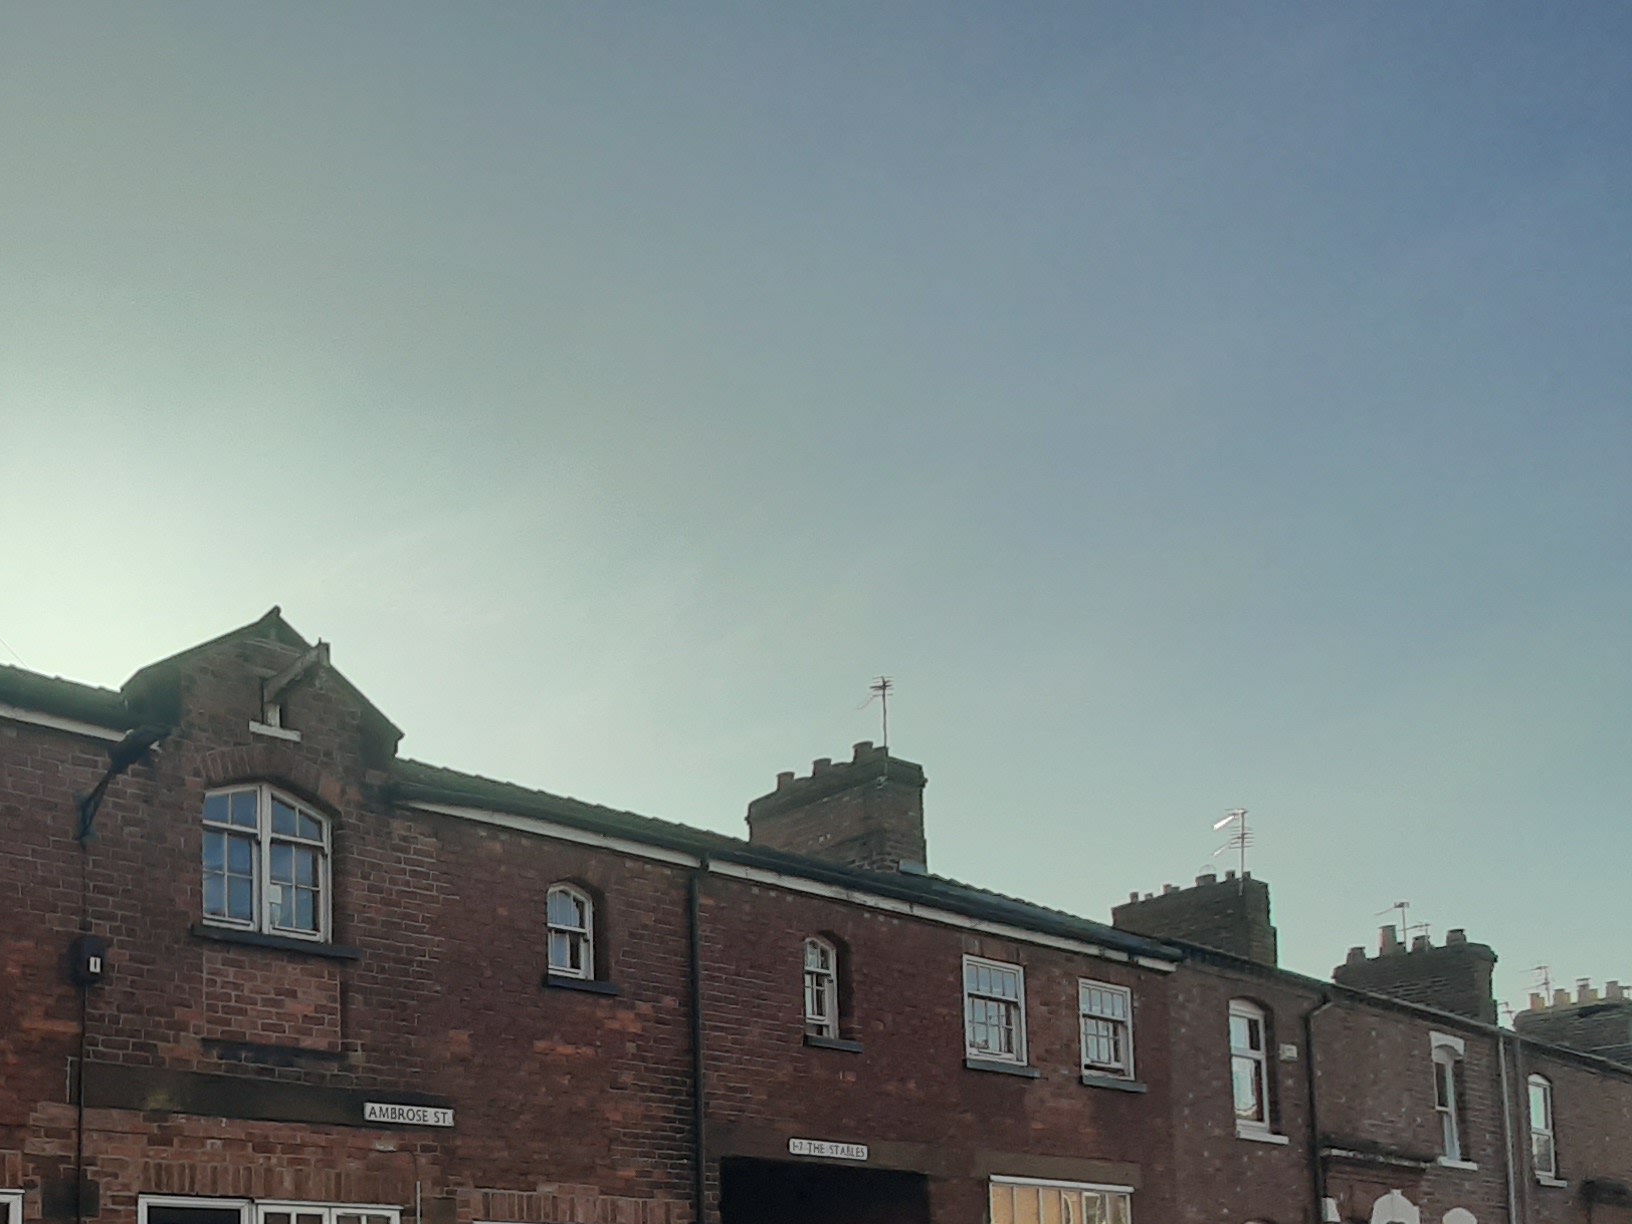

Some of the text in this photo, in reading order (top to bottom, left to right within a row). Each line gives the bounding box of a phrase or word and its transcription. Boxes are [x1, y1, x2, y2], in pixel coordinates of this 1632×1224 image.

[368, 1106, 429, 1122] AMBROSE
[807, 1142, 825, 1155] THE
[829, 1144, 865, 1158] STABLES
